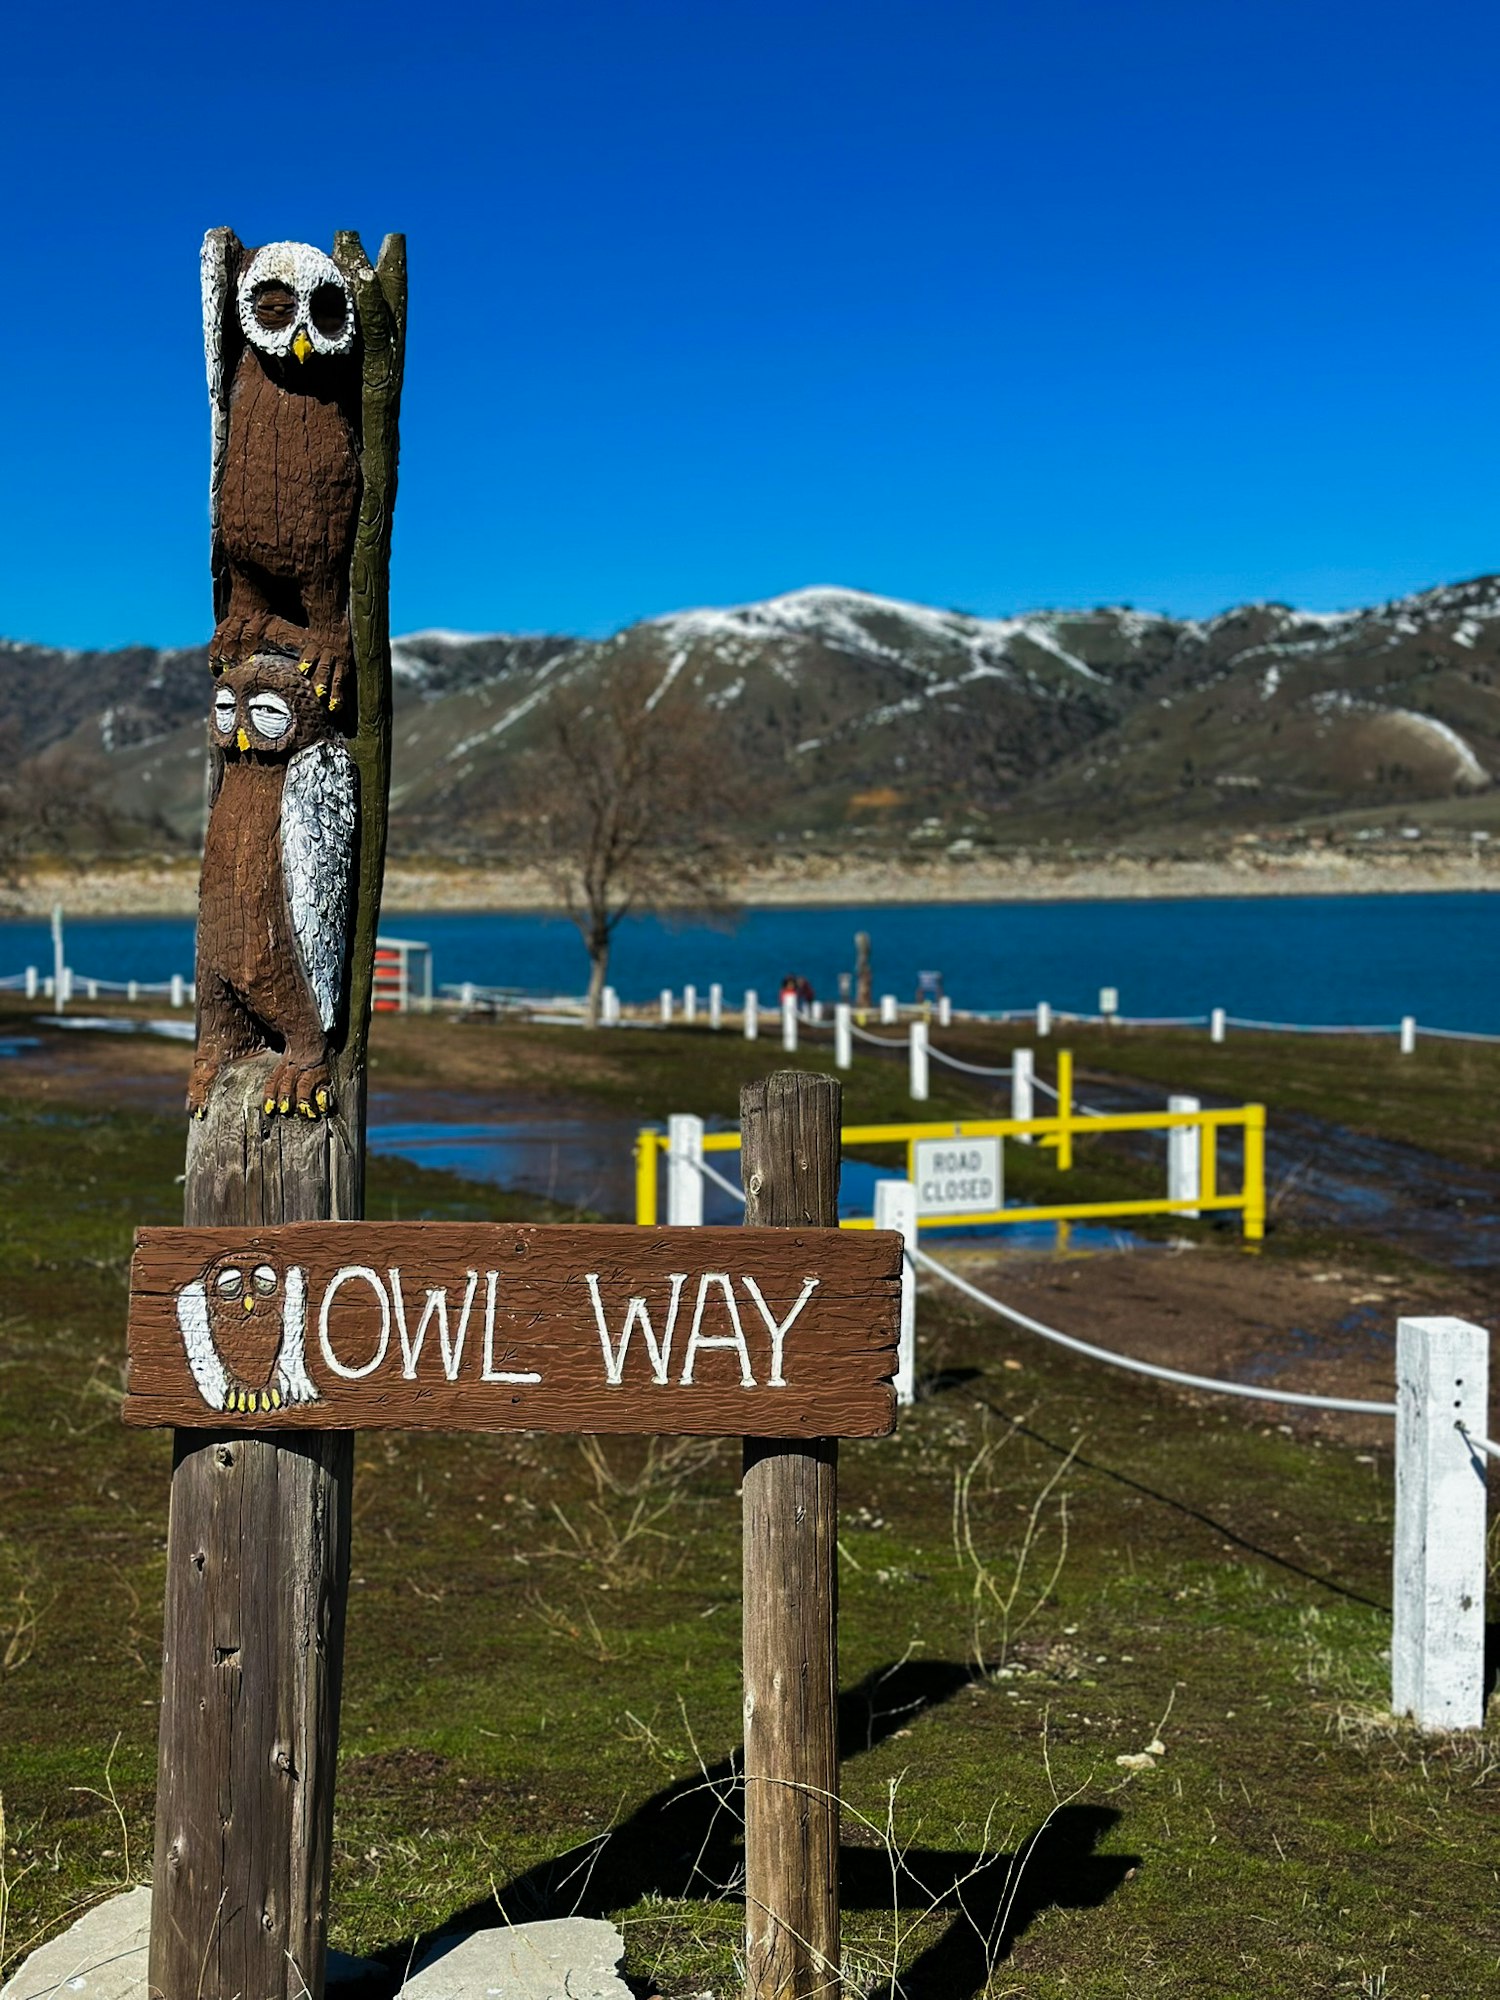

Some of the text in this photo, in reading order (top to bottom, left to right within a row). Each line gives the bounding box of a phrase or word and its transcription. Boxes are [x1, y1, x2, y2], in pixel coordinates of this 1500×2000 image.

[933, 1150, 982, 1173] ROAD
[922, 1178, 993, 1202] CLOSED
[318, 1265, 821, 1387] OWL WAY
